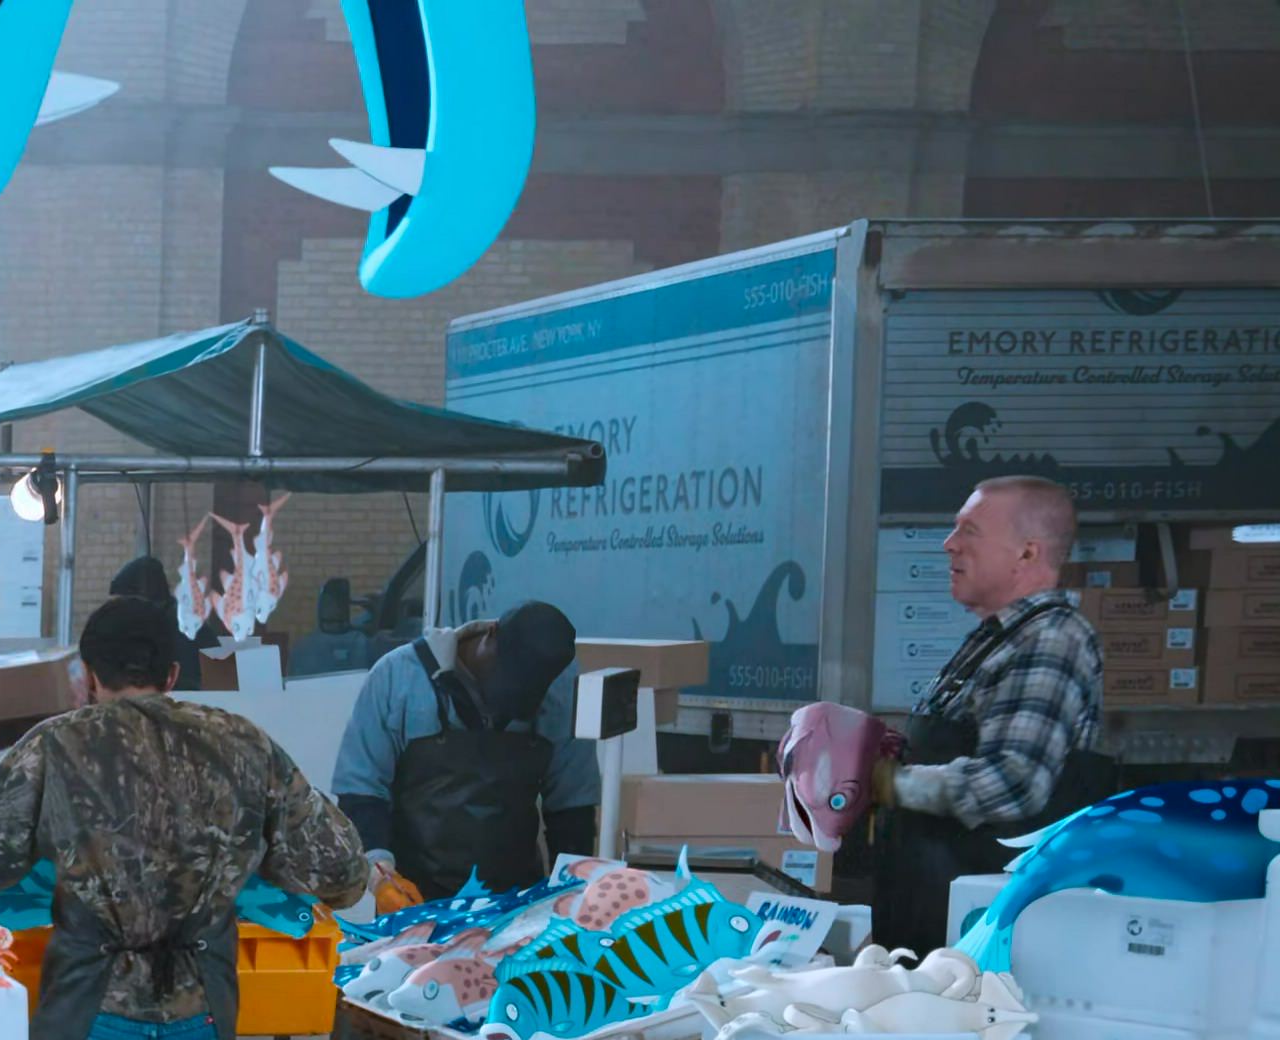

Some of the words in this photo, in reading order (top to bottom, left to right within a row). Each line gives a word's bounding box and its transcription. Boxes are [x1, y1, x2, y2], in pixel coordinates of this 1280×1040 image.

[744, 271, 828, 310] 555-010-FISH
[948, 329, 1056, 354] EMORY
[1070, 328, 1280, 354] REFRIGERATI
[957, 366, 1067, 389] Temperature
[1073, 364, 1163, 384] Controlled
[1167, 363, 1232, 388] Storage
[550, 465, 763, 519] REFRIGERATION
[546, 531, 607, 555] Temperature
[610, 525, 665, 550] Controlled
[667, 523, 709, 551] Storage
[711, 521, 764, 546] Solutions
[728, 664, 814, 689] 555-010-FISH
[757, 901, 819, 930] RAINBOW
